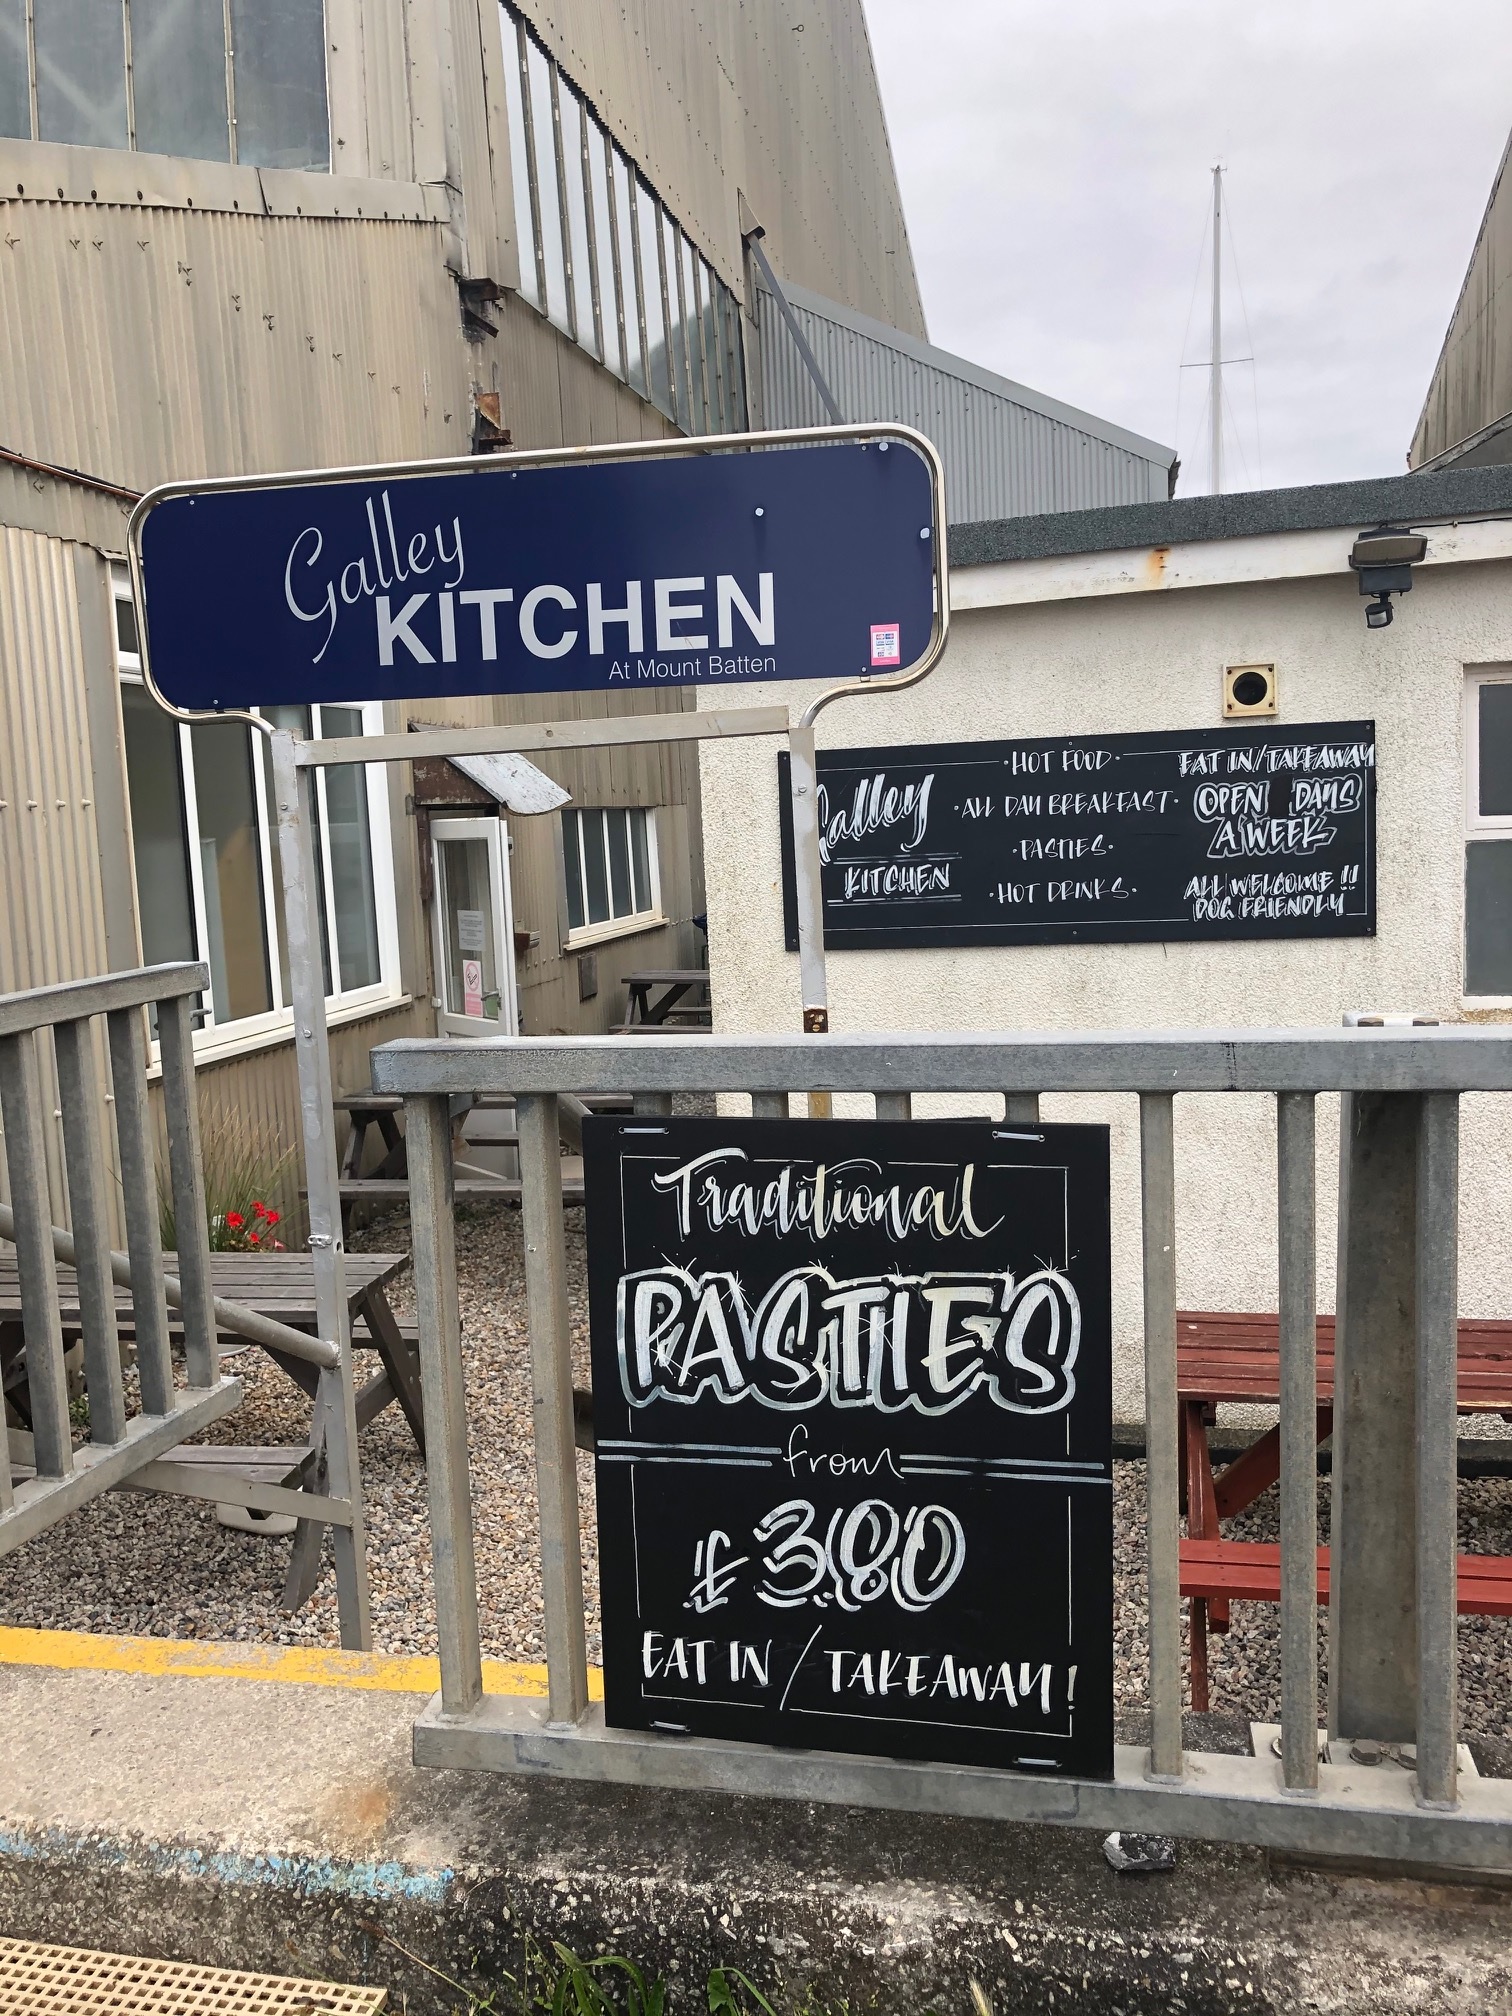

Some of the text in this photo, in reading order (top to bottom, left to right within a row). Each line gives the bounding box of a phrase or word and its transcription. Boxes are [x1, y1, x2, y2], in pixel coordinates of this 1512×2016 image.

[284, 489, 465, 664] Galley
[375, 572, 775, 667] KITCHEN
[608, 655, 776, 680] At Mount Batten
[1011, 749, 1112, 776] HOT FOOD
[1178, 749, 1226, 777] EAT
[961, 789, 1174, 819] ALL DAY BREAKFAST
[1198, 777, 1355, 818] OPEN DAYS
[1019, 834, 1107, 861] PASTIES
[1215, 815, 1329, 850] A WEEK
[844, 863, 951, 900] KITCHEN
[997, 876, 1130, 904] HOT DRINKS
[1183, 874, 1225, 900] ALL
[1230, 870, 1335, 898] WELCOME
[1193, 893, 1345, 922] DOG FRIENDLY
[652, 1147, 1006, 1243] Traditional
[618, 1262, 1082, 1414] PASTIES
[782, 1424, 905, 1479] from
[641, 1630, 715, 1684] EAT
[729, 1639, 772, 1687] IN
